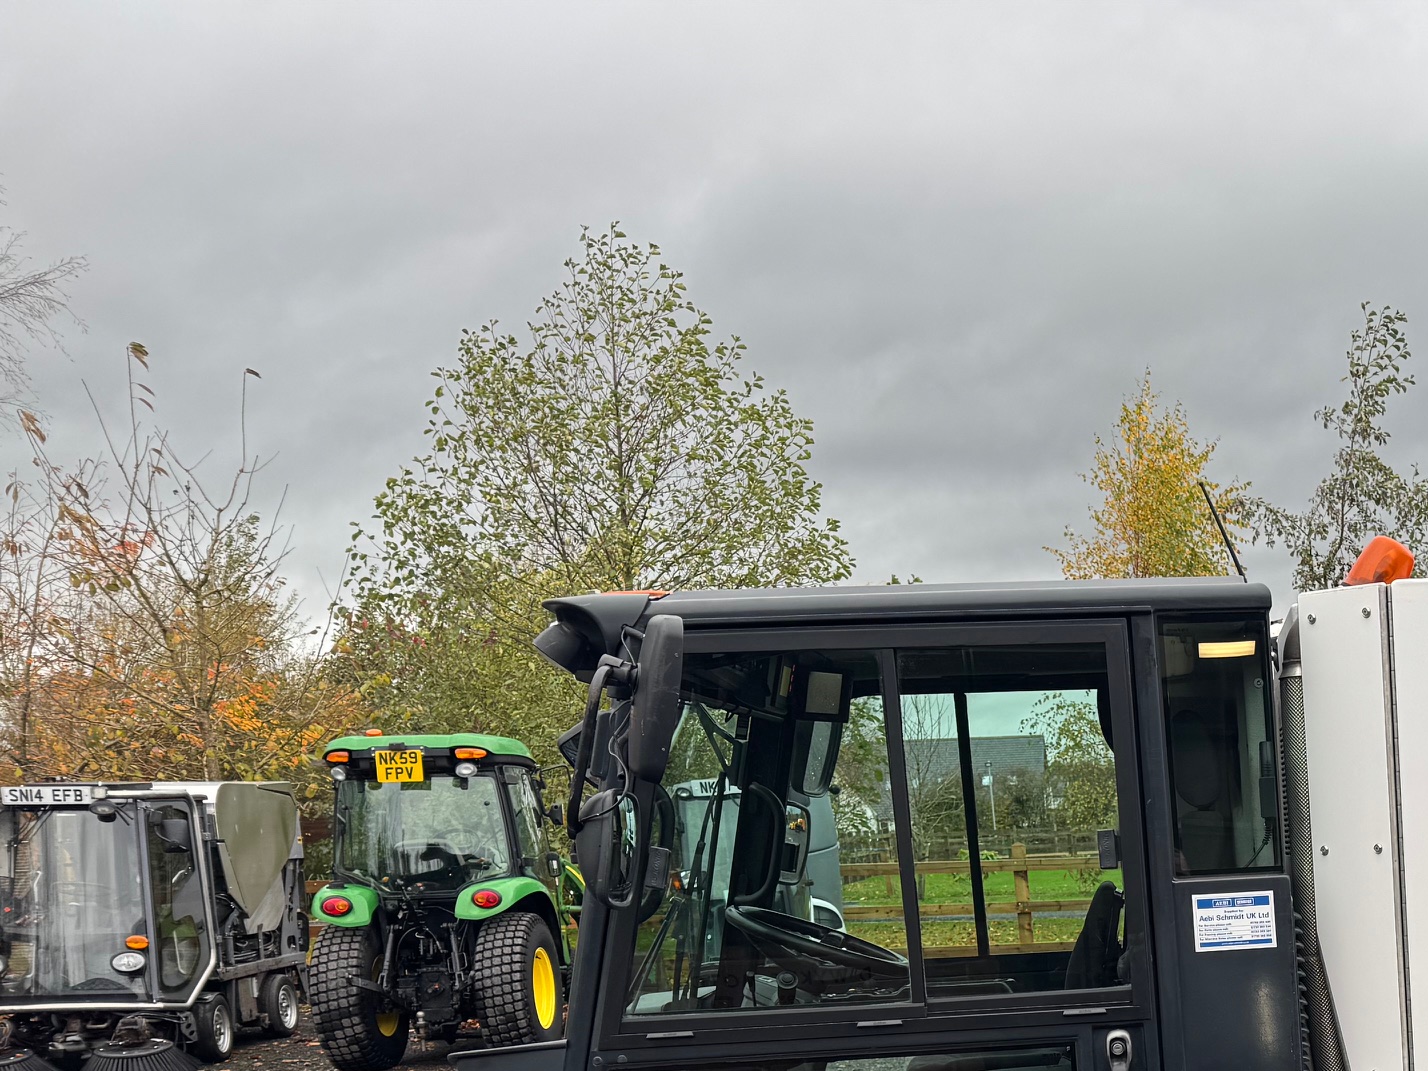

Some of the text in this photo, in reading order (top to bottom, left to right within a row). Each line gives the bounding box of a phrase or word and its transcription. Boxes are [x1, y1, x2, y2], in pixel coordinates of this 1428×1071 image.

[379, 751, 417, 765] NK59
[385, 766, 413, 780] FPV
[9, 788, 83, 802] SN14 EFB
[1216, 913, 1244, 921] Schmidt
